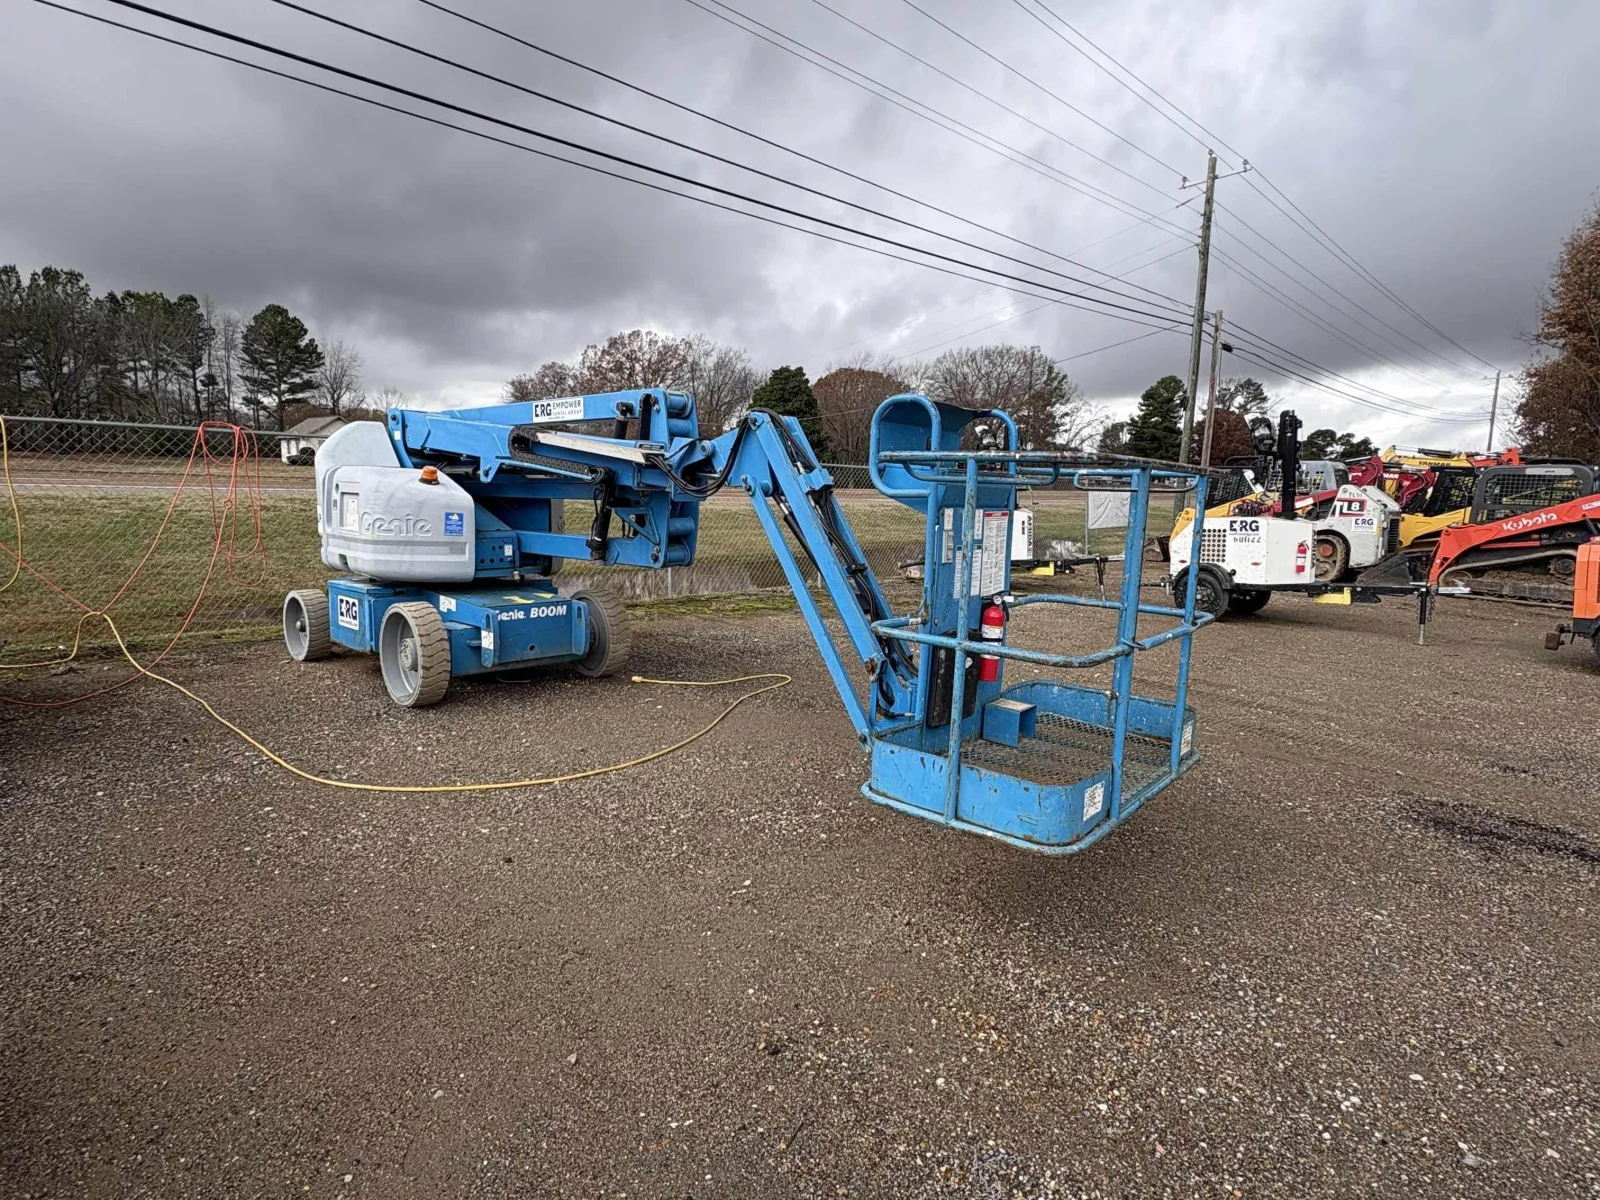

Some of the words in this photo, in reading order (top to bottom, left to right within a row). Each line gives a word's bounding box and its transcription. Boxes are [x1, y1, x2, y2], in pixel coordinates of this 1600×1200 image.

[534, 403, 552, 418] ERG
[552, 399, 582, 410] EMPOWER
[1334, 500, 1361, 518] TL8
[361, 511, 432, 537] Genie
[1229, 519, 1260, 532] ERG
[1354, 518, 1374, 526] ERG
[1502, 512, 1558, 531] Kubota
[339, 598, 358, 621] ERG
[529, 604, 567, 619] BOOM
